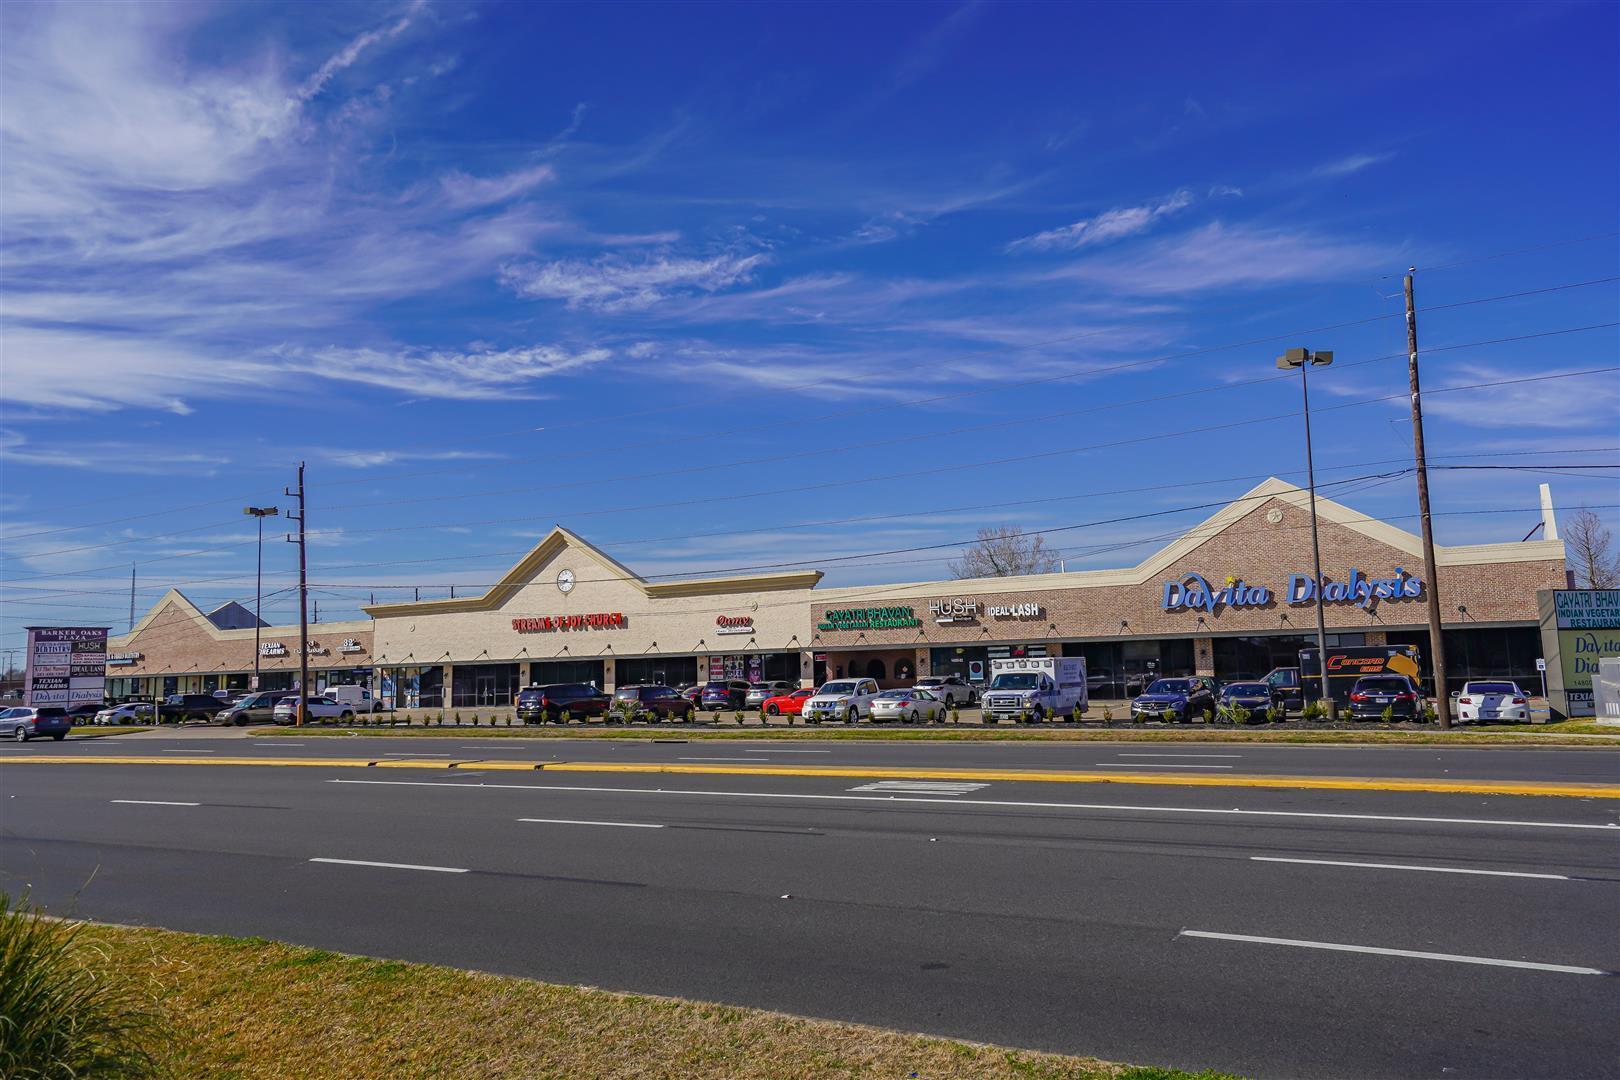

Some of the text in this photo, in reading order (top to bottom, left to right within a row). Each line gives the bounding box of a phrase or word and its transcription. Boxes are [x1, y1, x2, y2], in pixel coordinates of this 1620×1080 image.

[1161, 572, 1269, 613] DaVita
[929, 598, 976, 615] HUSH
[1557, 592, 1592, 608] GAYATRI
[826, 606, 911, 620] GAYATRI BHAVAN
[1012, 603, 1039, 616] LASH
[1558, 609, 1584, 618] INDIAN
[512, 612, 622, 631] STREAMS OF JOY CHURCH
[870, 618, 919, 628] RESTAURANT
[71, 691, 102, 700] Dialysis
